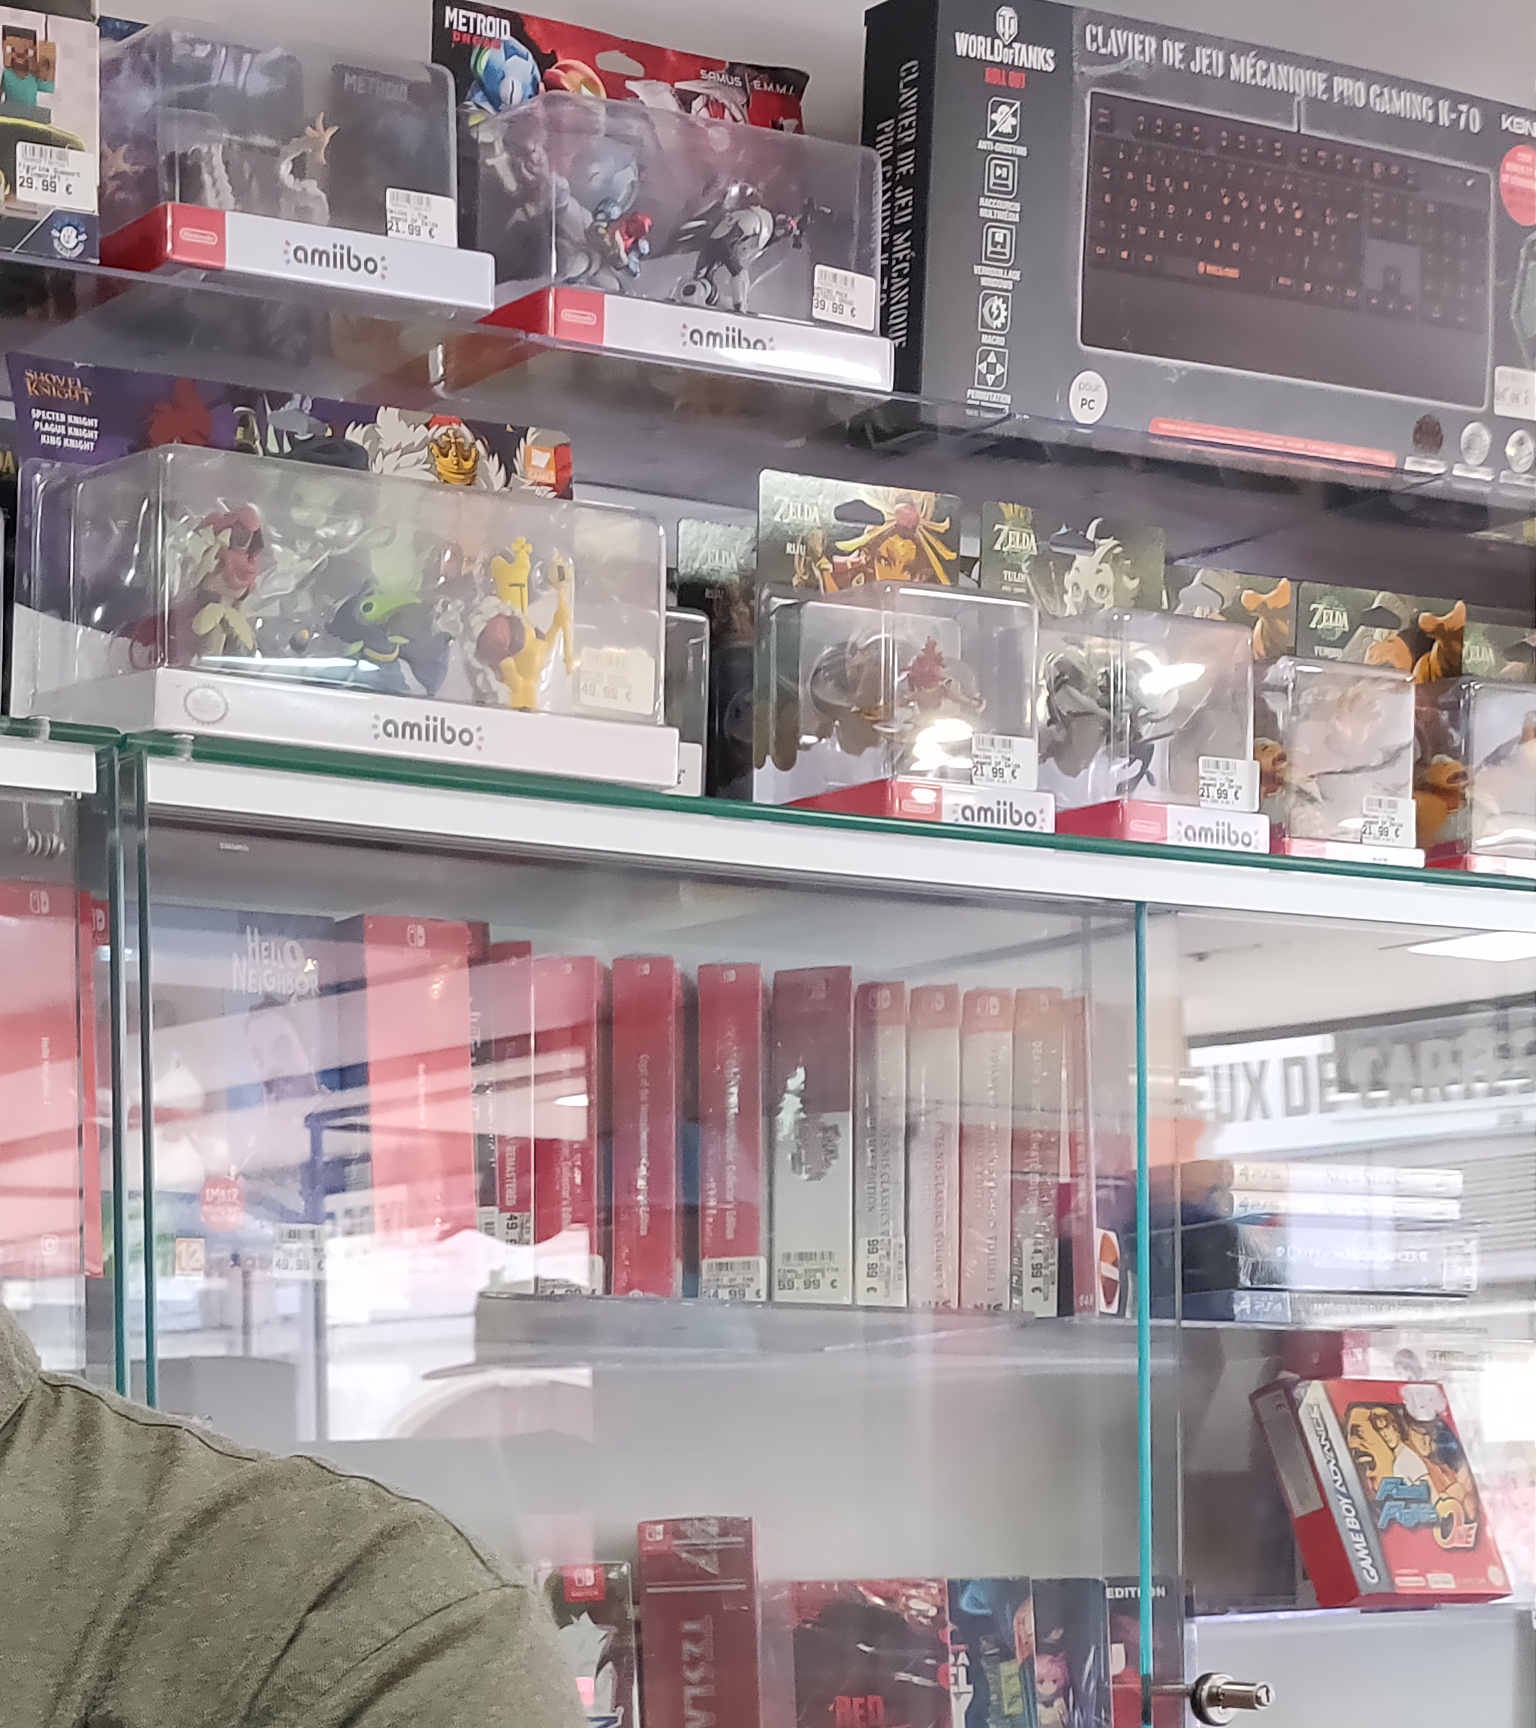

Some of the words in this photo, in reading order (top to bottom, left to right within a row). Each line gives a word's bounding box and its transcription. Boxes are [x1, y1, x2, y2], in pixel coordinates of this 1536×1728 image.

[445, 8, 510, 41] METROID
[700, 69, 741, 87] SAMUS
[1086, 23, 1156, 63] CLAVIER
[1163, 38, 1184, 67] DE
[1191, 47, 1224, 77] JEU
[1230, 51, 1327, 99] MÉCANIQUE
[1334, 79, 1365, 107] PRO
[1370, 87, 1434, 120] GAMING
[18, 175, 58, 192] 29.99
[64, 182, 72, 195] €
[293, 242, 378, 275] amiibo
[26, 382, 92, 405] KNIGHT
[1080, 398, 1095, 411] PC
[34, 421, 64, 435] PLAGUE
[67, 426, 99, 441] KNIGHT
[67, 414, 98, 428] KNIGHT
[40, 434, 60, 446] KING
[64, 436, 95, 451] KNIGHT
[381, 715, 475, 749] amiibo
[973, 761, 1004, 778] 21.99
[1009, 767, 1017, 780] €
[960, 802, 1039, 829] amiibo
